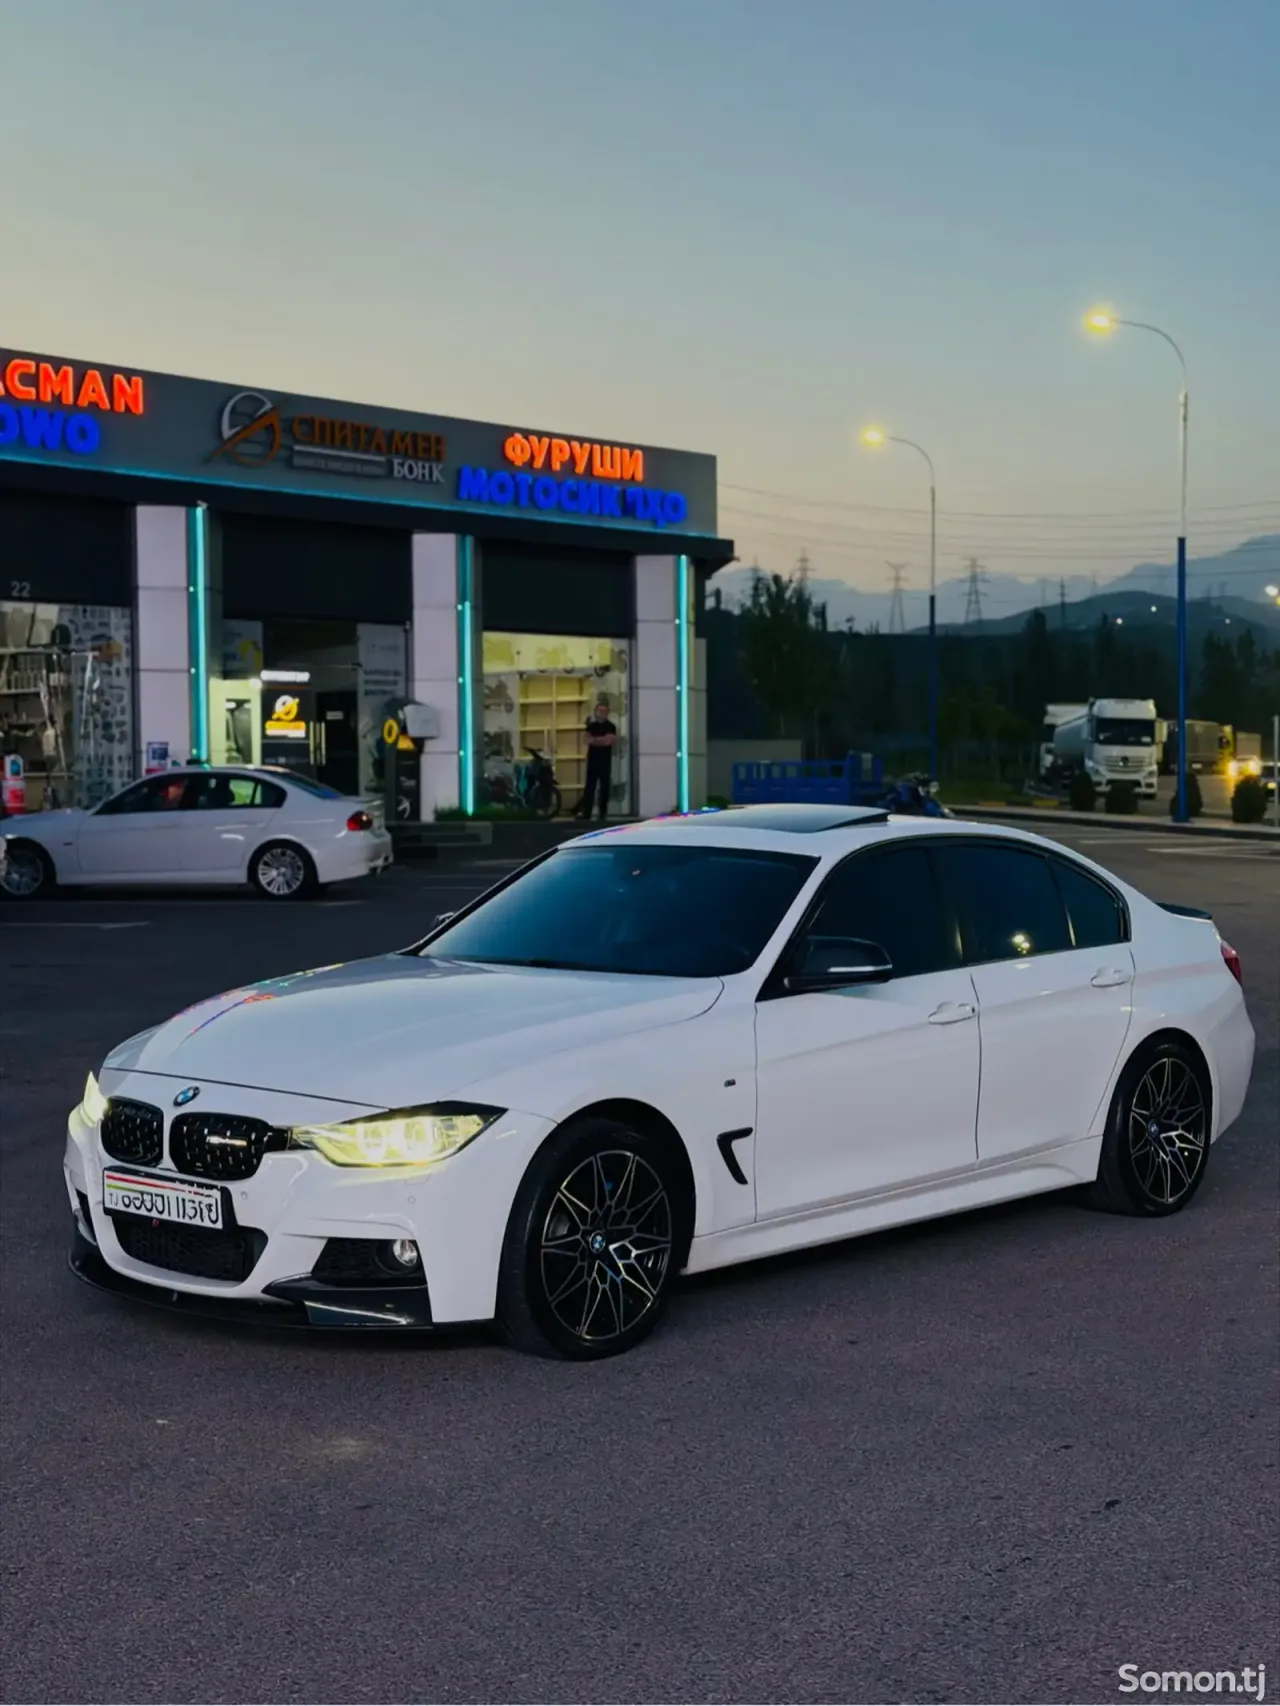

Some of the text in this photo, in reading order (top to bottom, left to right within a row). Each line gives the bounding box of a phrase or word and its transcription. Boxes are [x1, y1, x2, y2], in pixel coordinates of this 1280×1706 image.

[0, 359, 144, 415] CMAN
[292, 414, 447, 462] СПИТАМЕН
[504, 432, 644, 482] ФУРУШИ
[393, 457, 445, 484] БОНК
[11, 580, 31, 598] 22
